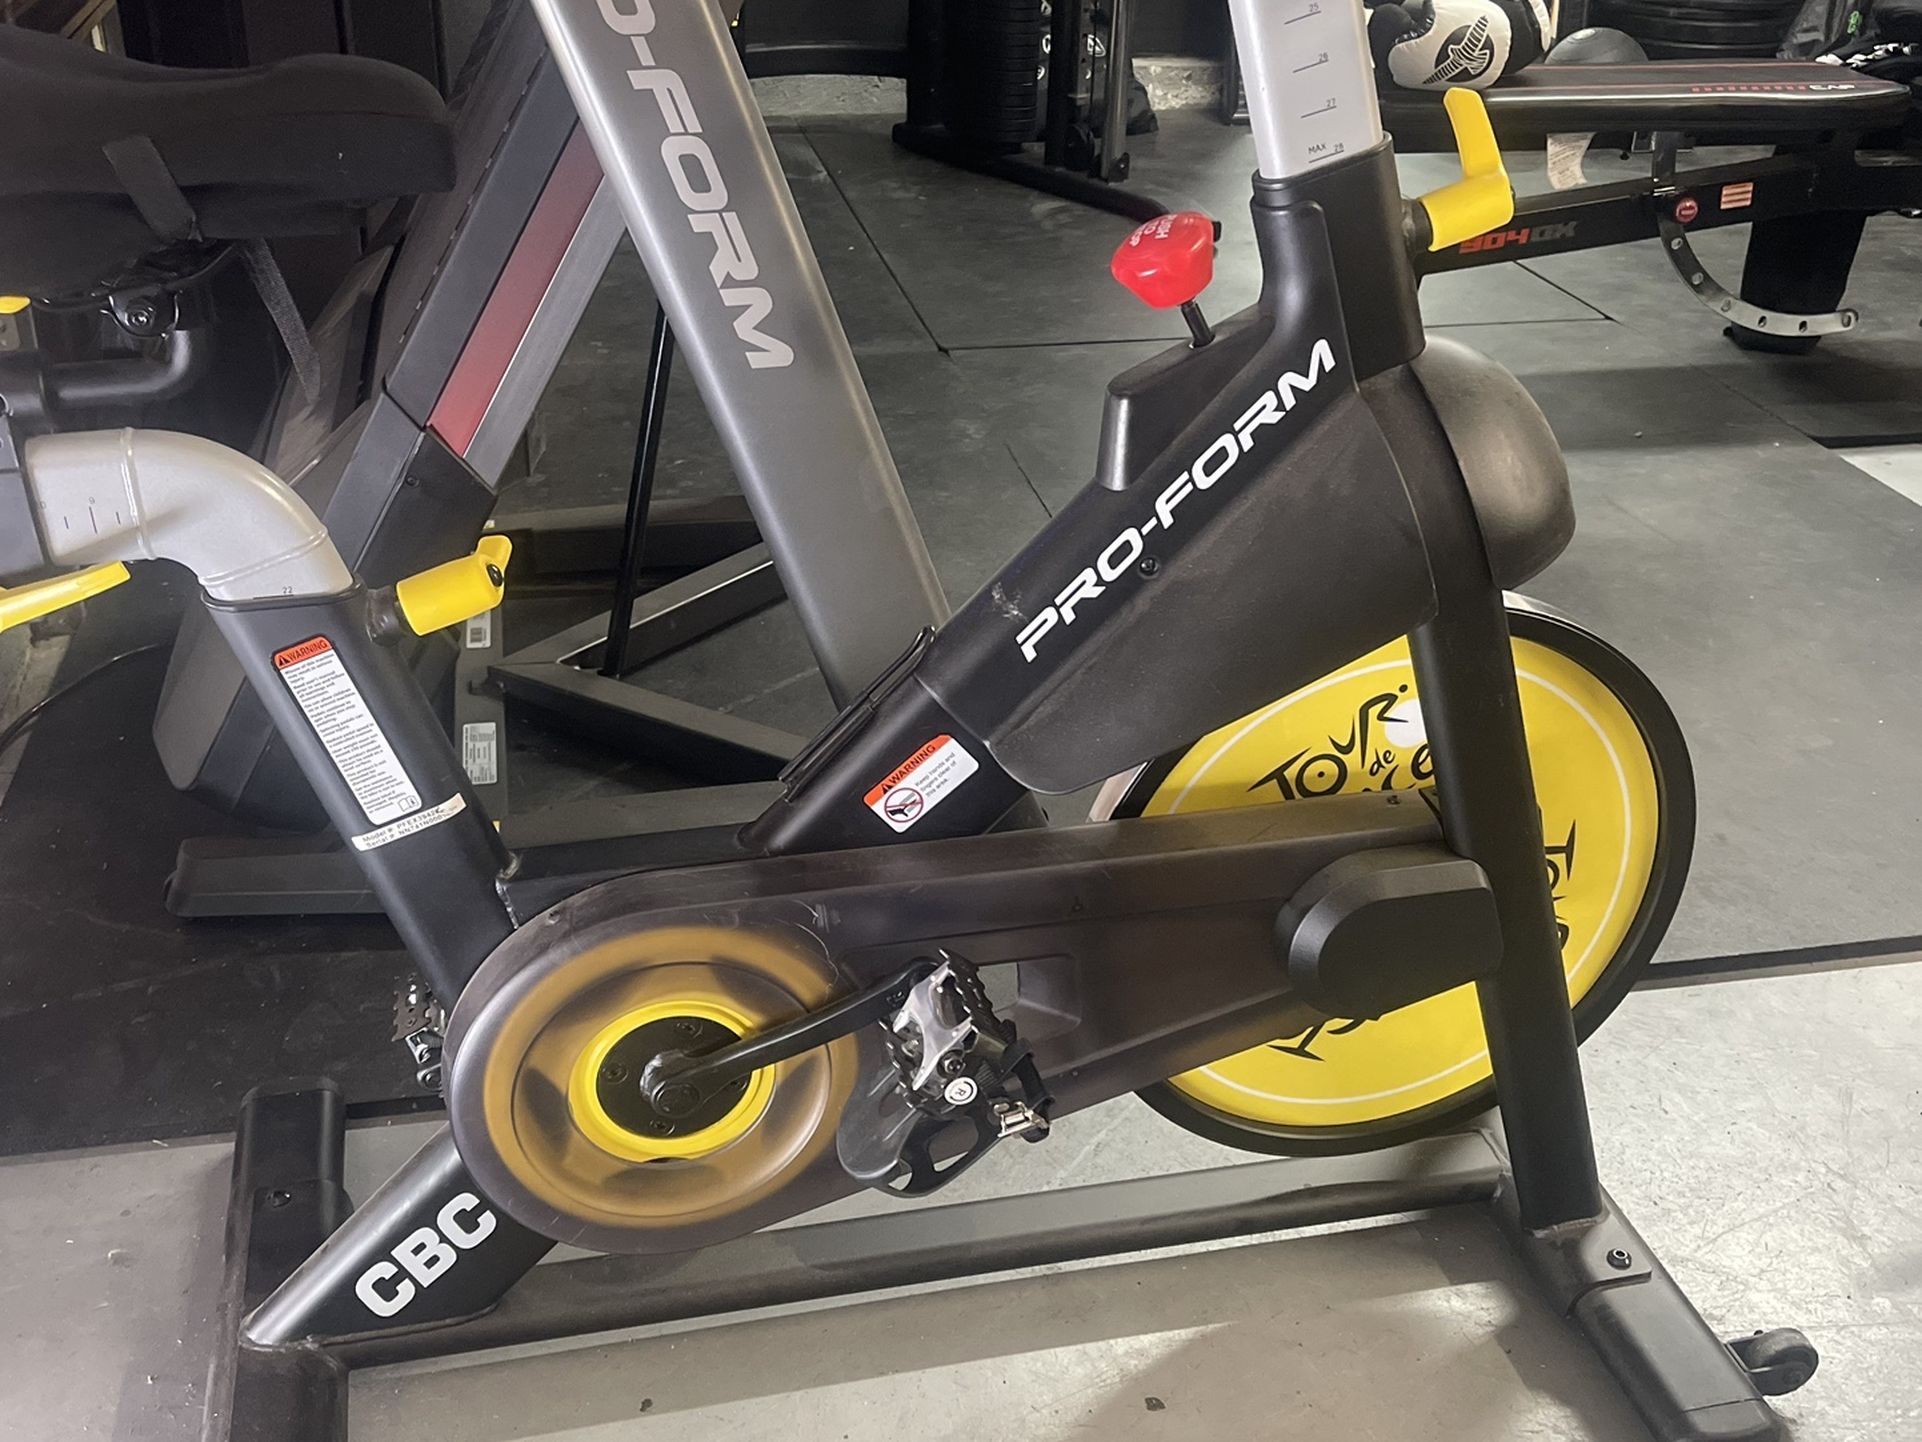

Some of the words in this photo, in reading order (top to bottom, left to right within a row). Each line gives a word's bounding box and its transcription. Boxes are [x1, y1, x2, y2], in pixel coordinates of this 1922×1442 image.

[1326, 98, 1336, 107] 27
[1308, 142, 1327, 154] MAX
[1016, 338, 1336, 663] PRO-FORM
[282, 586, 293, 594] 22
[287, 640, 328, 661] WARNING
[890, 744, 936, 784] WARNING
[1369, 748, 1396, 777] de
[354, 1192, 497, 1317] CBC
